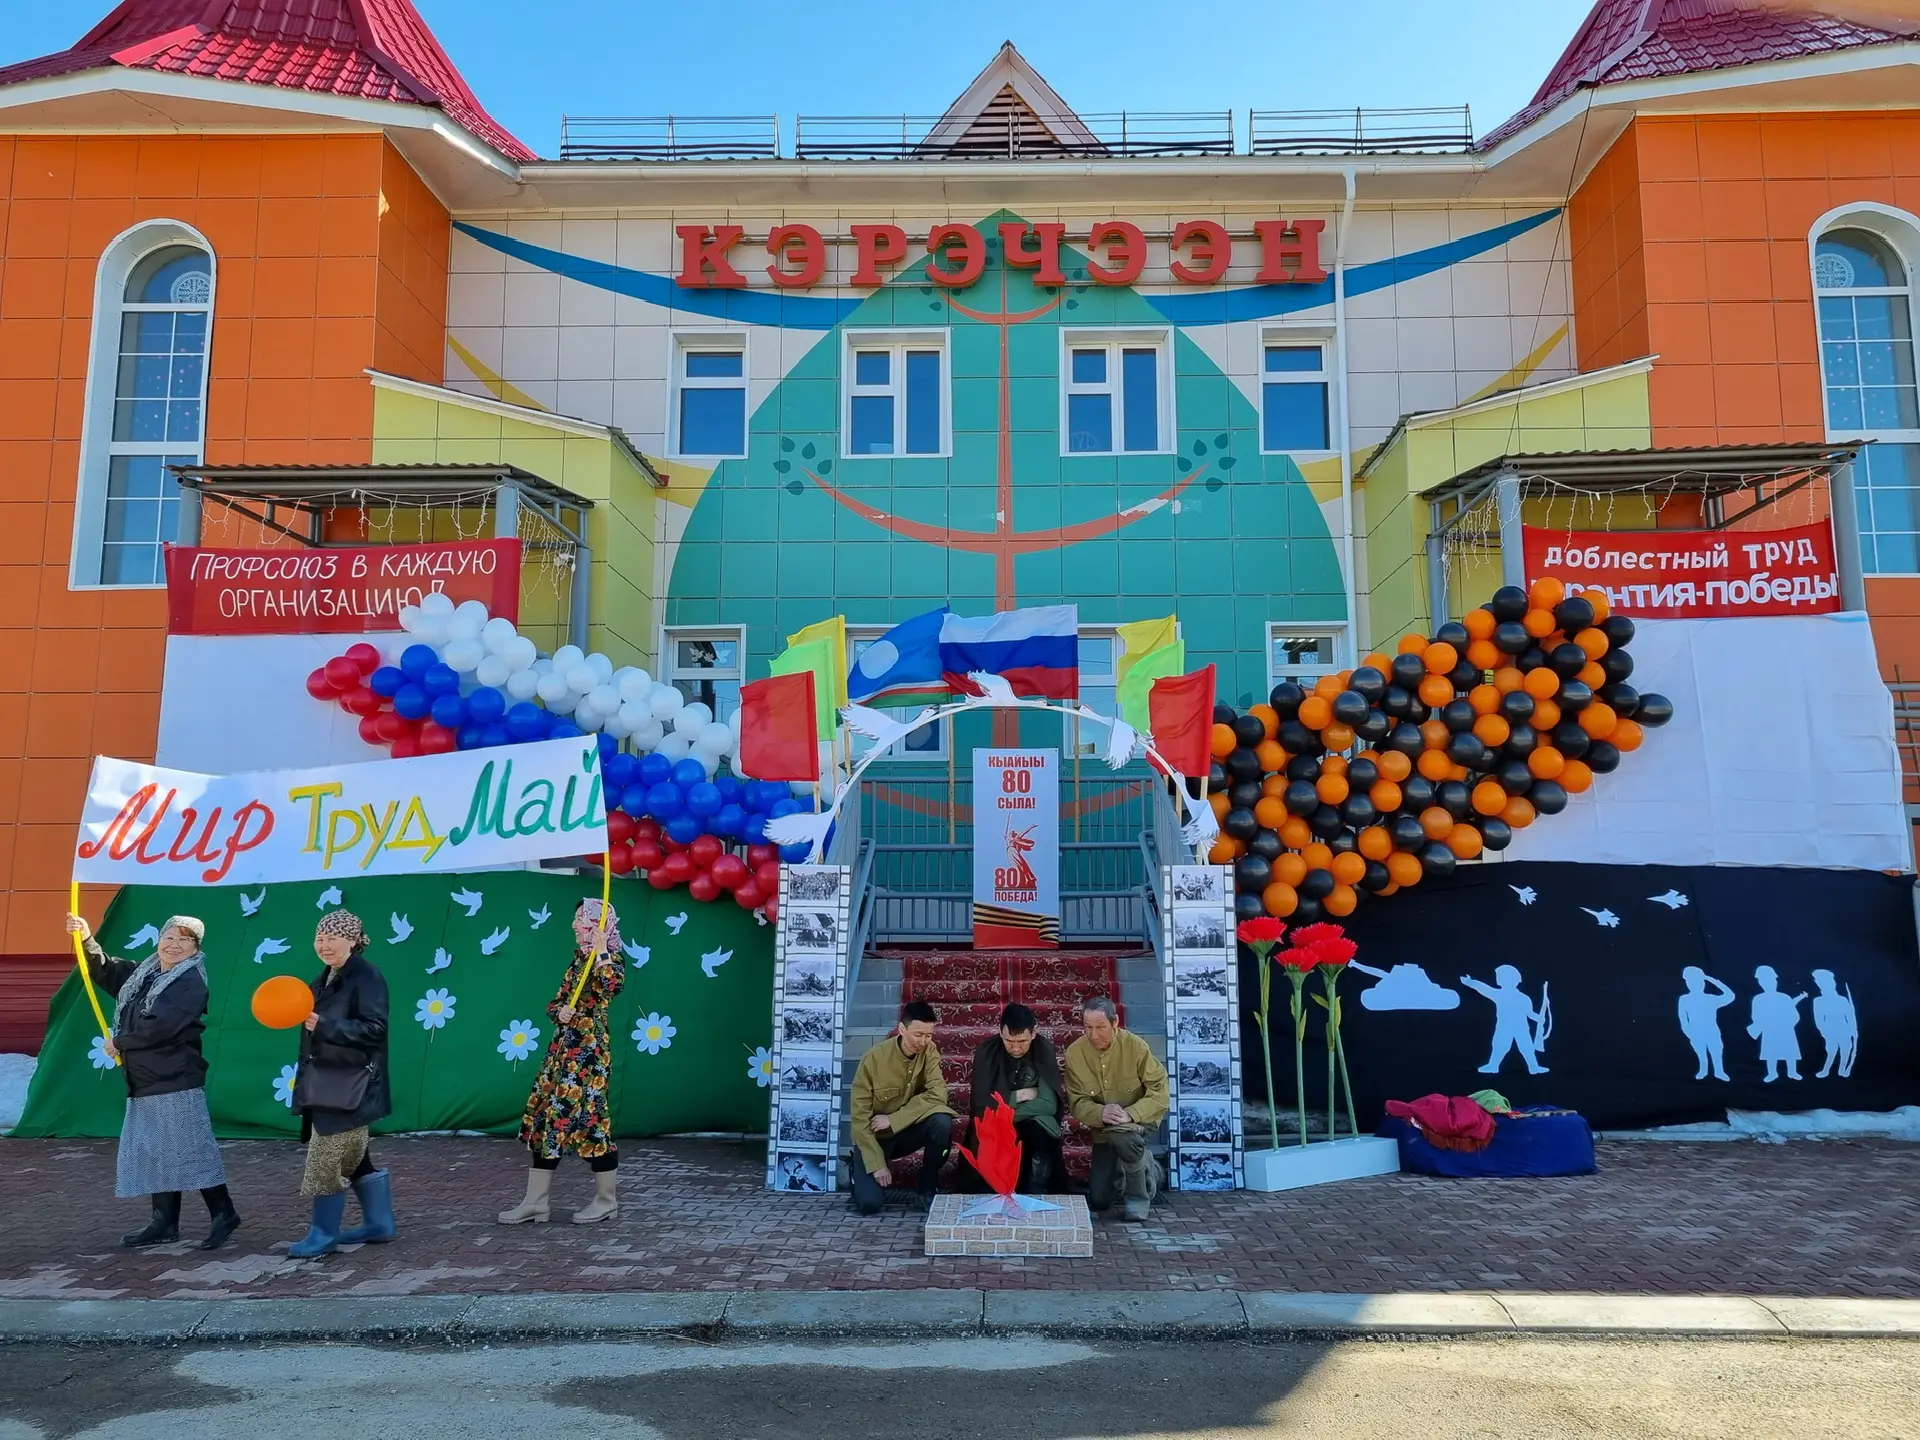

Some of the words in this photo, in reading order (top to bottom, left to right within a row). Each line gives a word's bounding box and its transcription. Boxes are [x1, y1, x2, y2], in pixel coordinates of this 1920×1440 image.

[676, 219, 1327, 289] КЭРЭЧЭЭН
[190, 553, 338, 580] ПРОФСОЮЗ
[352, 554, 368, 578] В
[380, 549, 497, 577] КАЖДУЮ
[988, 753, 1045, 768] КЫАЙЫЫ
[1002, 769, 1031, 794] 80
[78, 782, 275, 883] Мир
[288, 781, 447, 872] Труд
[449, 745, 606, 846] Май
[997, 797, 1036, 809] СЫЛА!
[994, 867, 1019, 888] 80
[994, 891, 1038, 903] ПОБЕДА!
